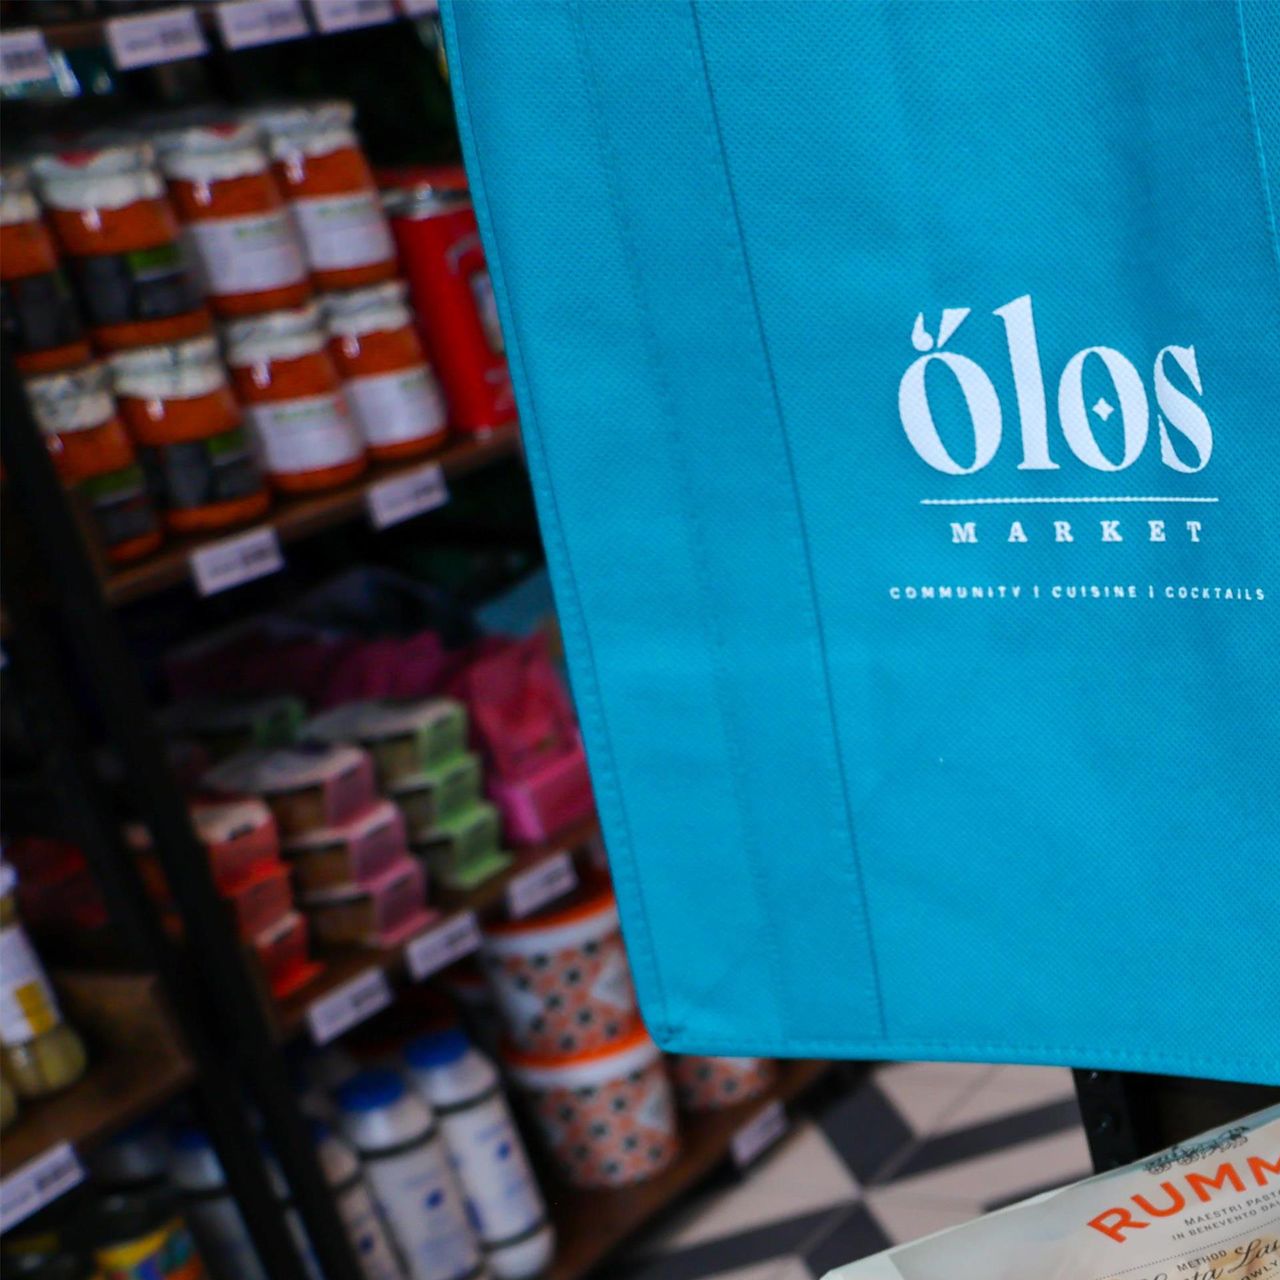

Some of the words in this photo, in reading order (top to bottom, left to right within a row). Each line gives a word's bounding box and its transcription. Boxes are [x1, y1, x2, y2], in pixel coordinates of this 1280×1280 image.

[950, 521, 1203, 544] MARKET
[889, 585, 1020, 599] COMMUNITY
[1052, 585, 1138, 598] CUISINE
[1166, 586, 1265, 600] COCKTAILS
